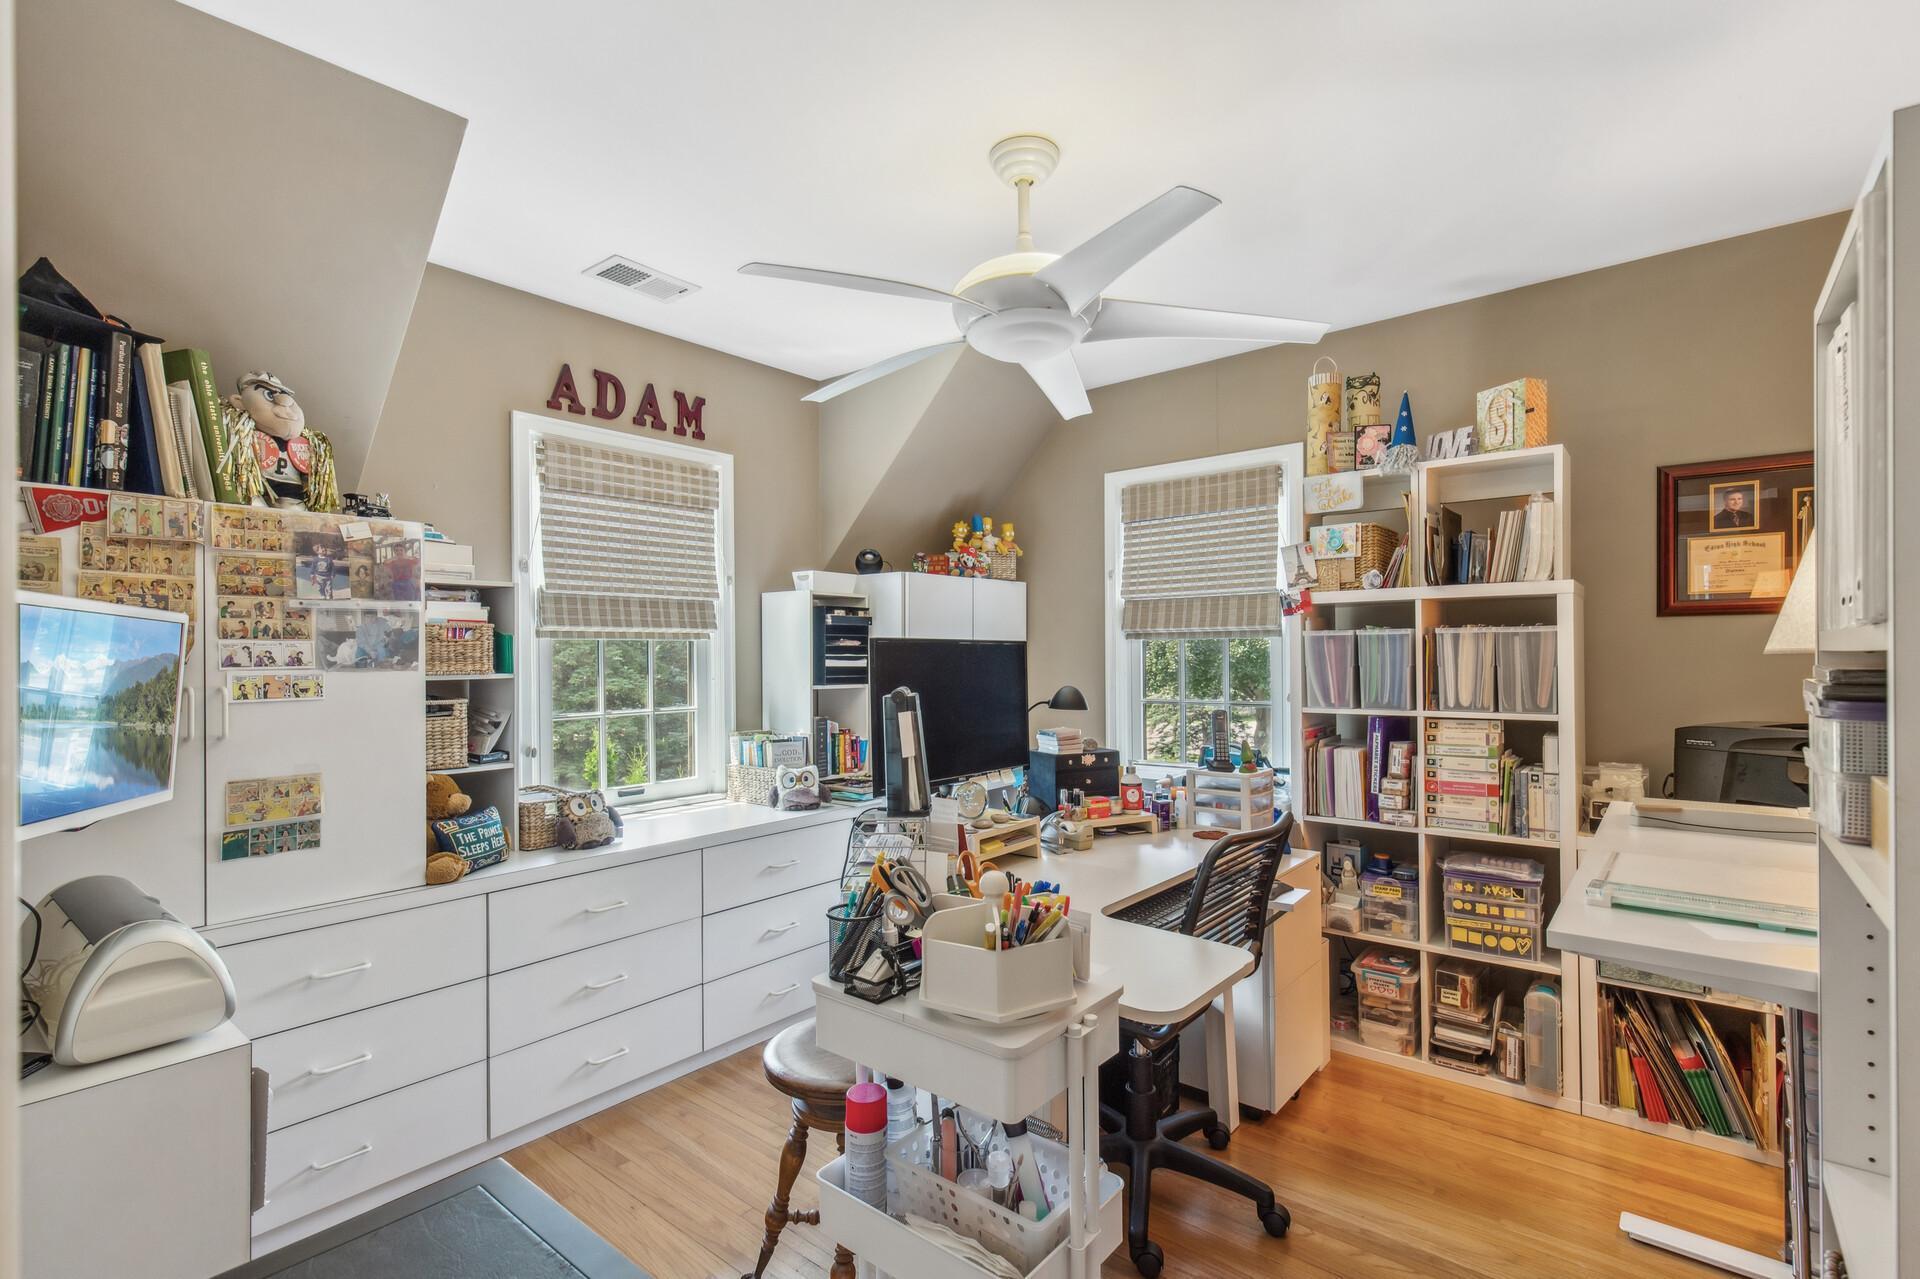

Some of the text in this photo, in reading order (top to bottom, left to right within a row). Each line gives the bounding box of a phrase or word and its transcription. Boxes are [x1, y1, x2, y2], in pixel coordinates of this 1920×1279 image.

[118, 340, 127, 363] Purdue
[115, 363, 126, 395] University
[200, 362, 208, 375] the
[204, 378, 212, 397] ohio
[208, 400, 217, 421] state
[547, 363, 706, 441] ADAM
[115, 402, 123, 418] 2008
[1425, 426, 1474, 460] LOVE
[275, 457, 288, 475] P
[111, 471, 119, 484] 121
[1743, 540, 1766, 548] School
[781, 749, 798, 757] GOD
[456, 824, 502, 845] THE PRINCE
[457, 835, 506, 857] SLEEPS HERE
